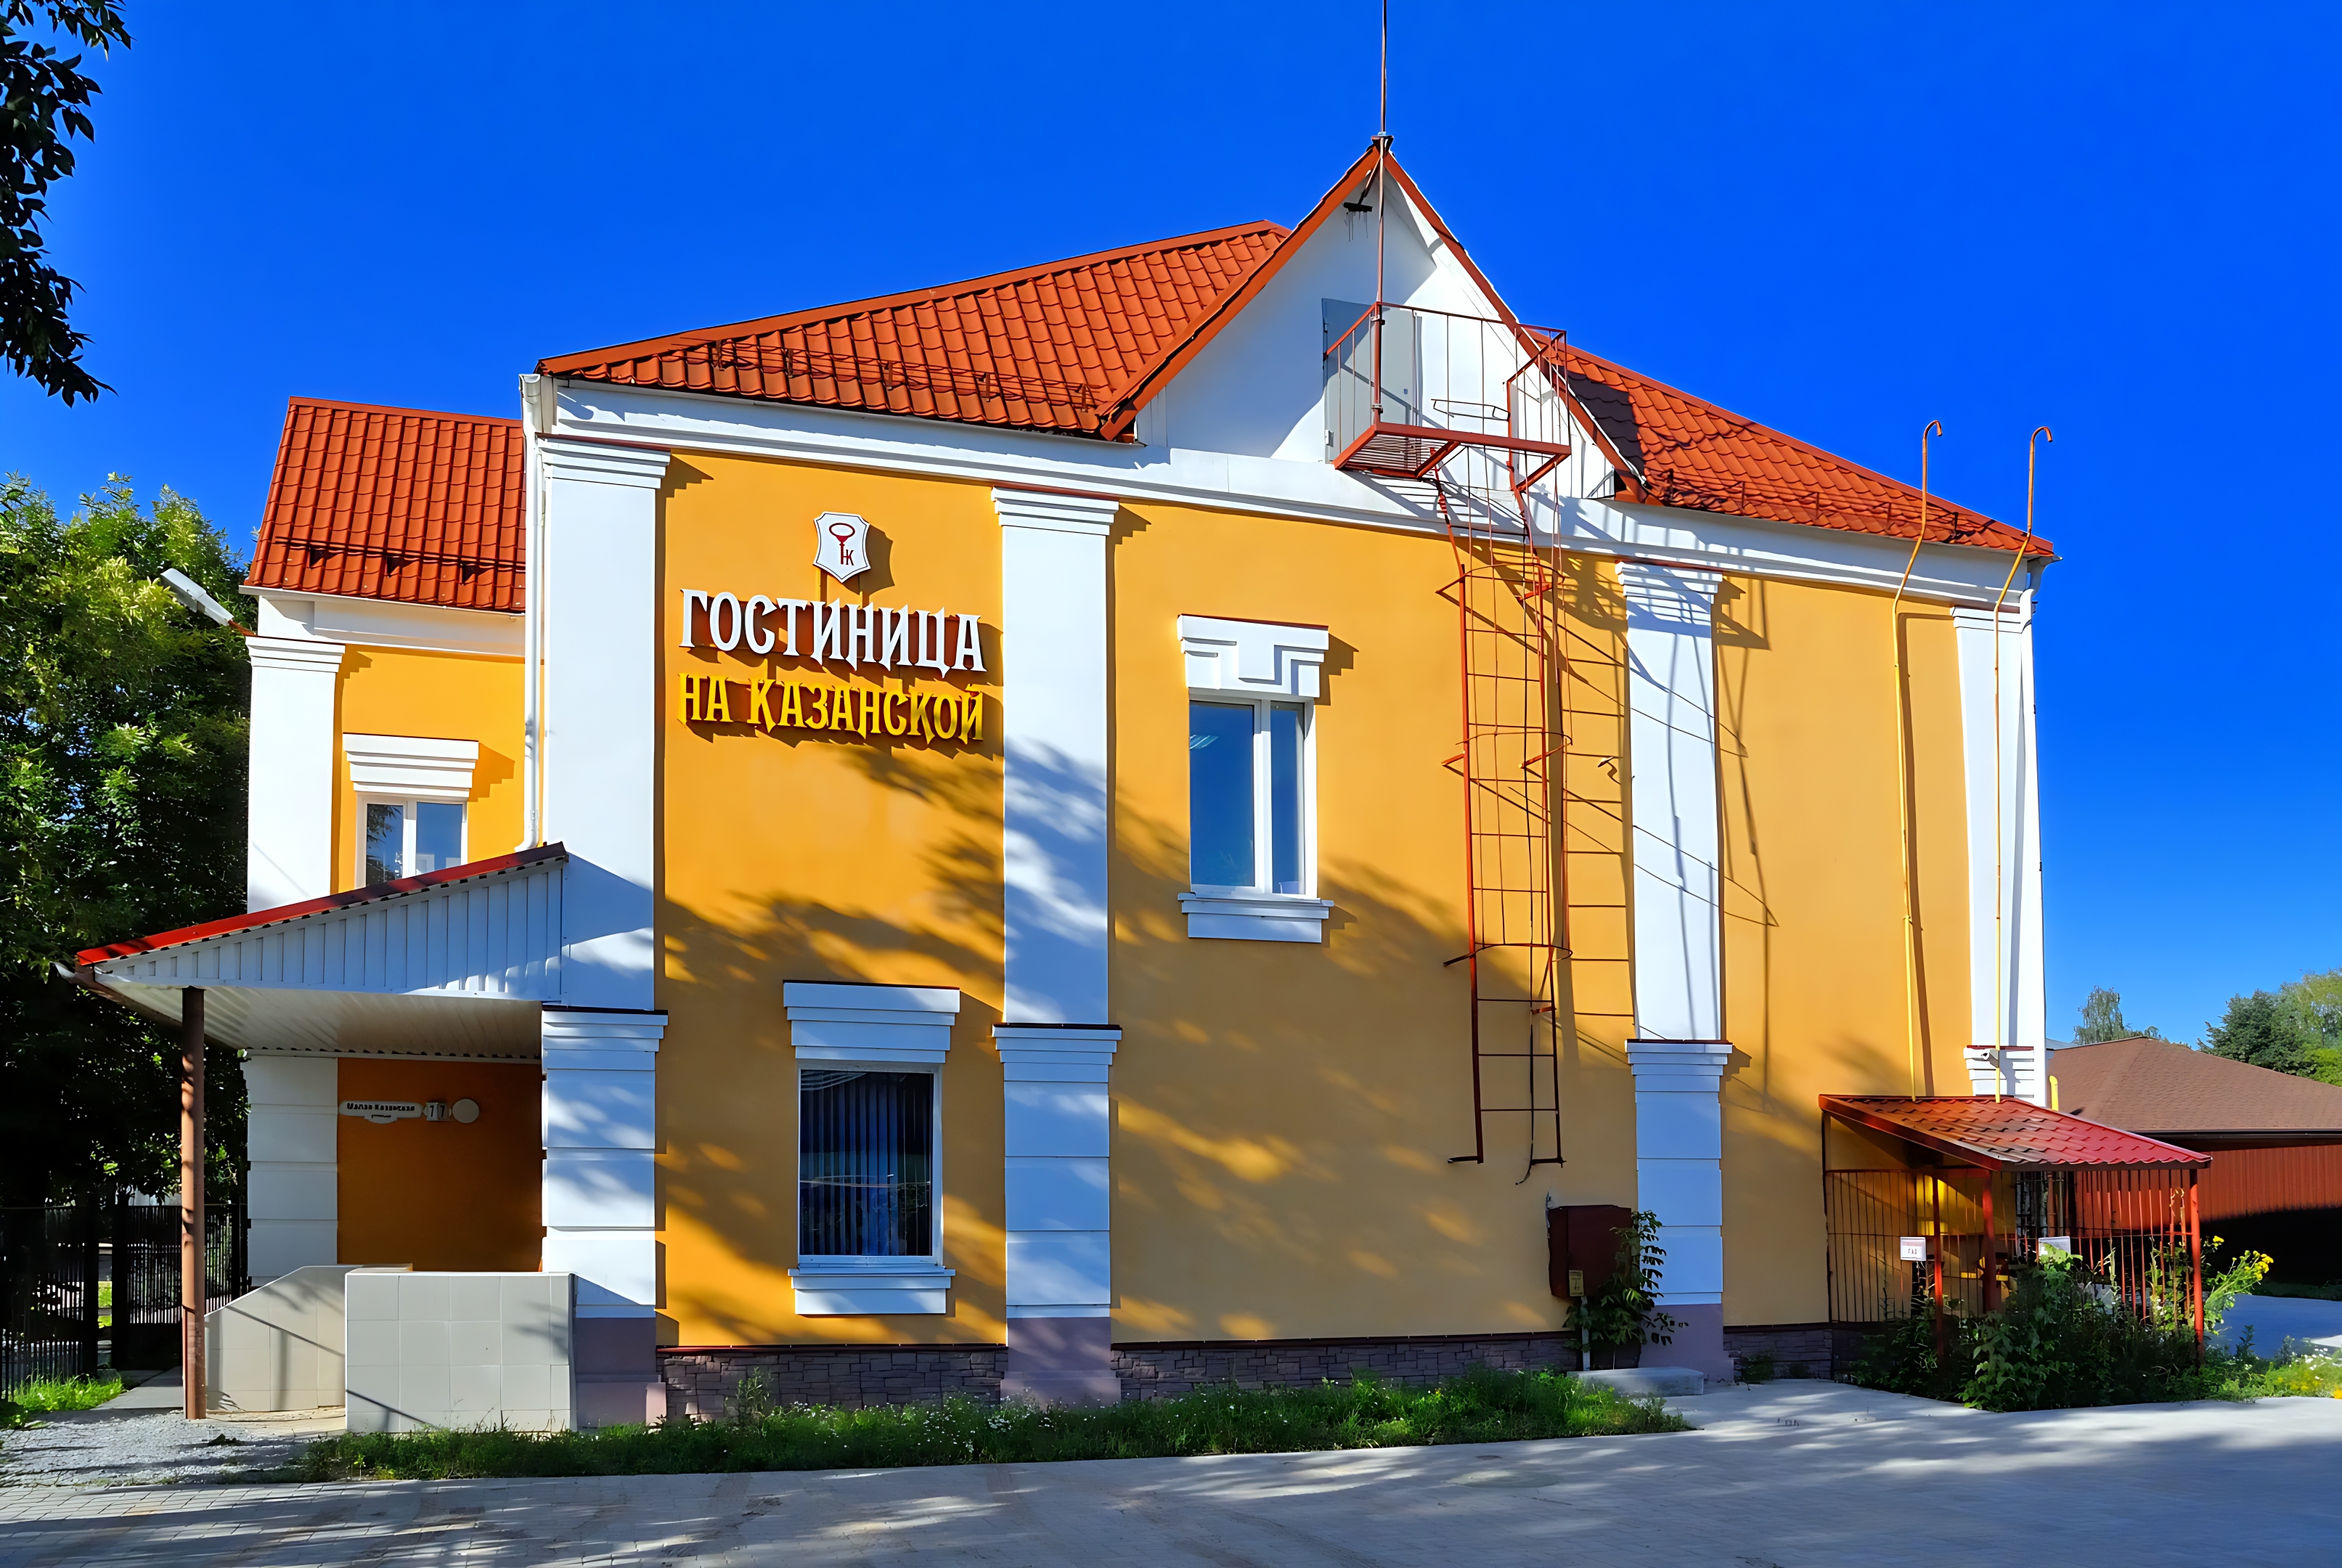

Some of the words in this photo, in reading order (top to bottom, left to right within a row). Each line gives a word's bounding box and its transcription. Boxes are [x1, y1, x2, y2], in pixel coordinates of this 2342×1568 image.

[679, 588, 987, 678] ГОСТИНИЦА
[677, 672, 733, 726] НА
[746, 677, 984, 745] КАЗАНСКОЙ
